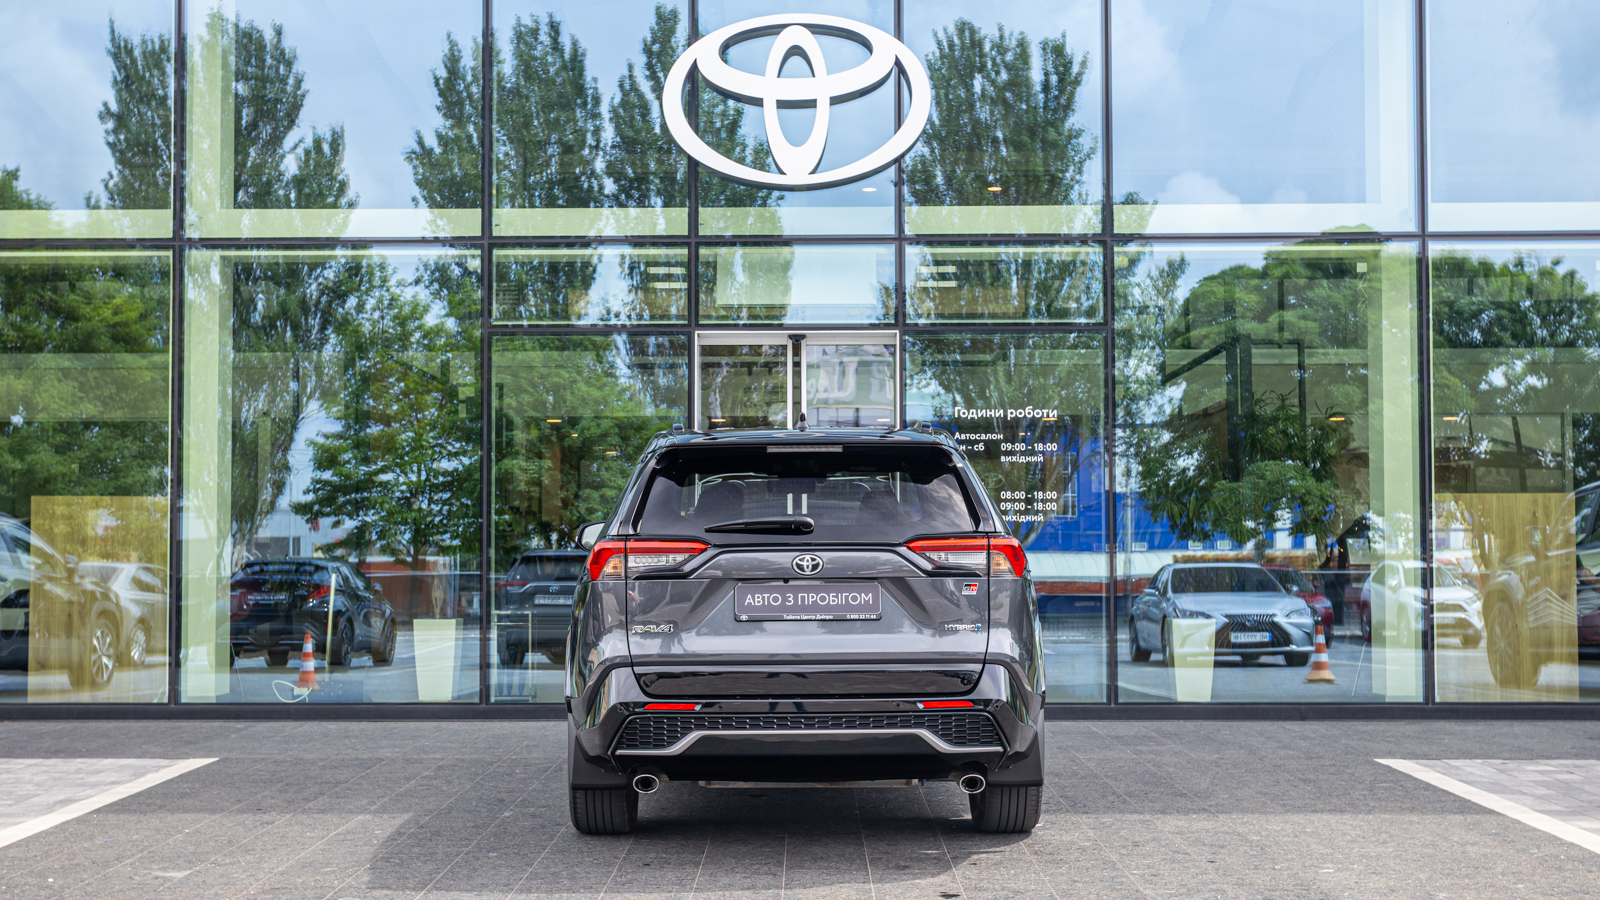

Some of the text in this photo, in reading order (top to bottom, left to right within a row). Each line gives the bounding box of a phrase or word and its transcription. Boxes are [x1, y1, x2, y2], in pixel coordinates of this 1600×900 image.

[954, 406, 1058, 420] Години роботи
[954, 431, 1004, 440] Автосалон
[973, 442, 985, 451] сб
[1000, 442, 1026, 451] 09:00
[1034, 442, 1058, 451] 18:00
[1000, 453, 1044, 463] вихідний
[1000, 491, 1026, 500] 08:00
[1033, 491, 1058, 500] 18:00
[1000, 502, 1026, 511] 09:00
[1033, 502, 1058, 511] 18:00
[744, 593, 782, 606] АВТО
[798, 593, 873, 606] ПРОБІГОМ
[632, 624, 674, 634] RAV4
